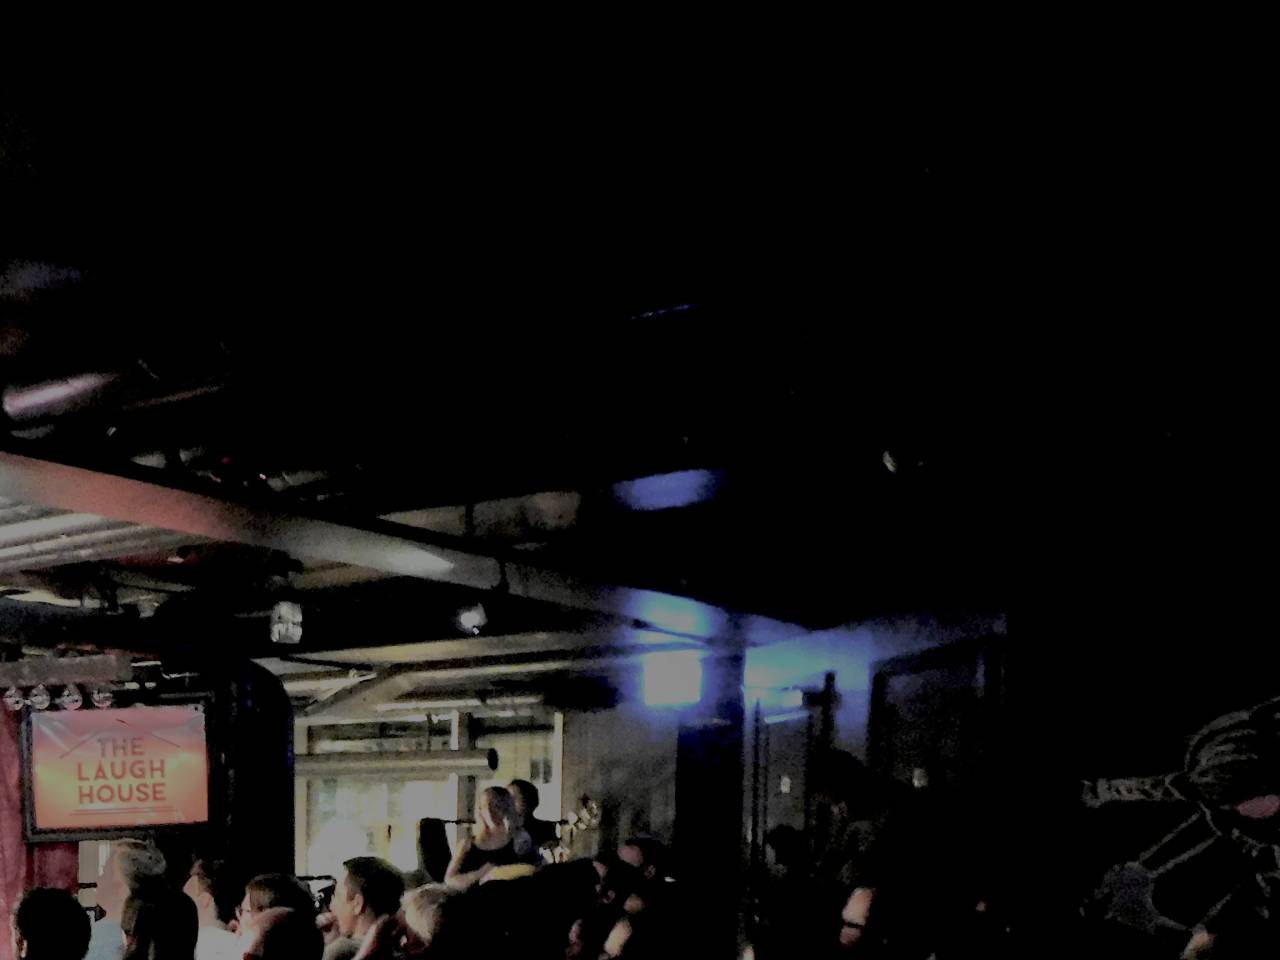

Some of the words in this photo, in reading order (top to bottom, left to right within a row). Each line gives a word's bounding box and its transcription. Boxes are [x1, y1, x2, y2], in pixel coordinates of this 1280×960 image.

[97, 737, 144, 757] THE
[77, 760, 165, 781] LAUGH
[79, 783, 166, 803] HOUSE
